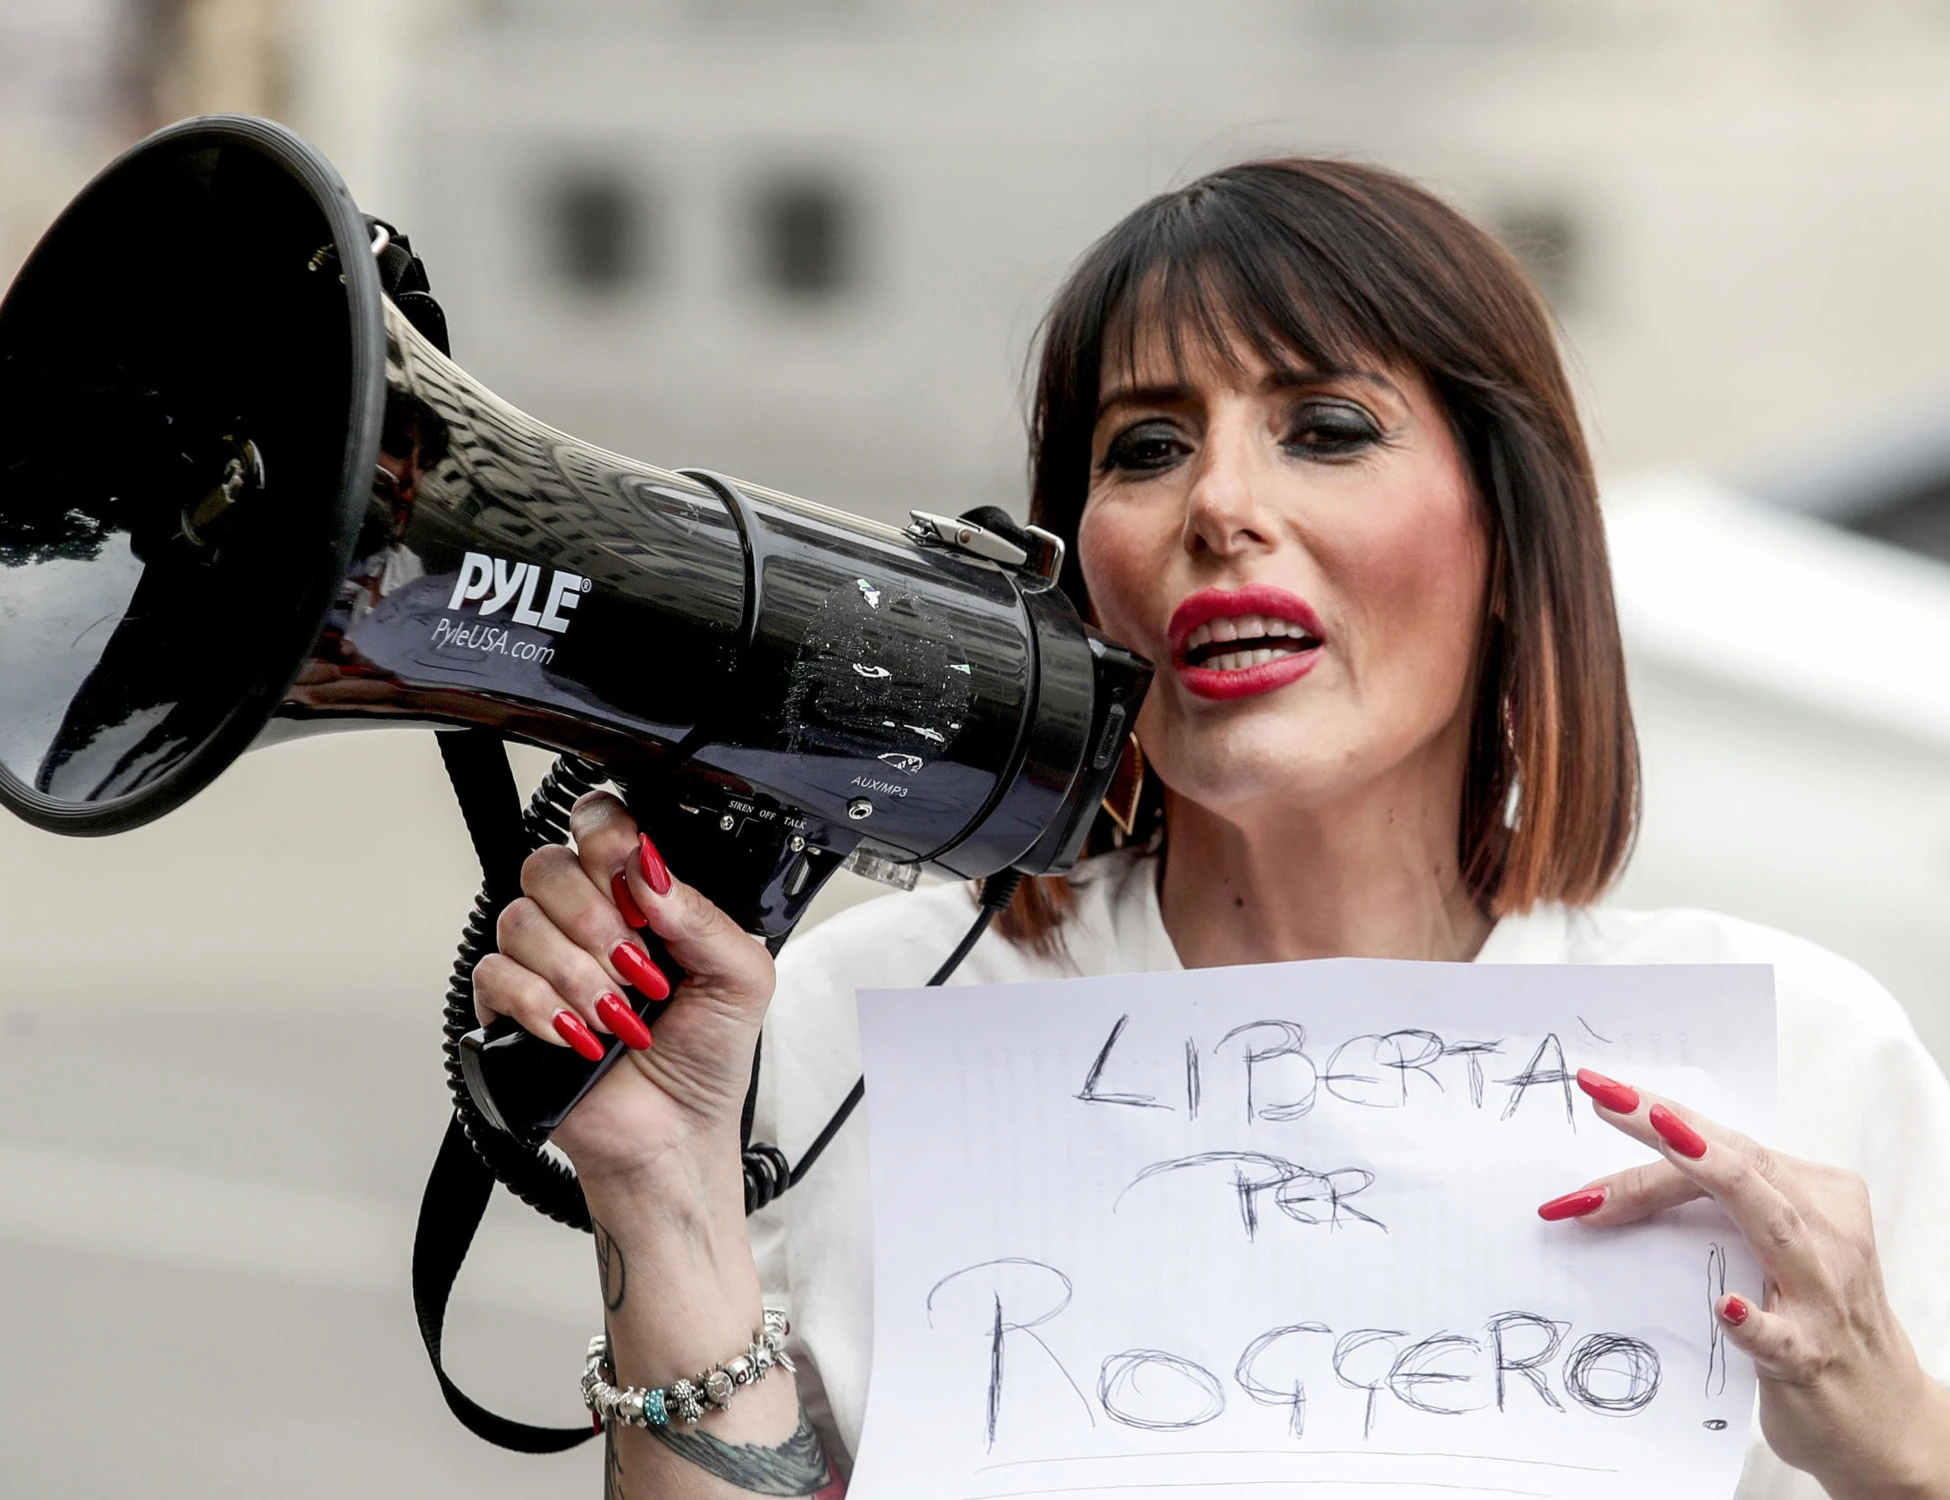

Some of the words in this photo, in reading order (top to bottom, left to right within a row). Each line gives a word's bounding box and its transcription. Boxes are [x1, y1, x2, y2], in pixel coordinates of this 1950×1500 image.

[431, 618, 555, 665] PyleUSA.com
[851, 776, 908, 798] AUX/MP3
[728, 800, 755, 813] SIREN
[759, 809, 777, 821] OFF
[783, 816, 807, 830] TALK
[1114, 1150, 1388, 1243] PER
